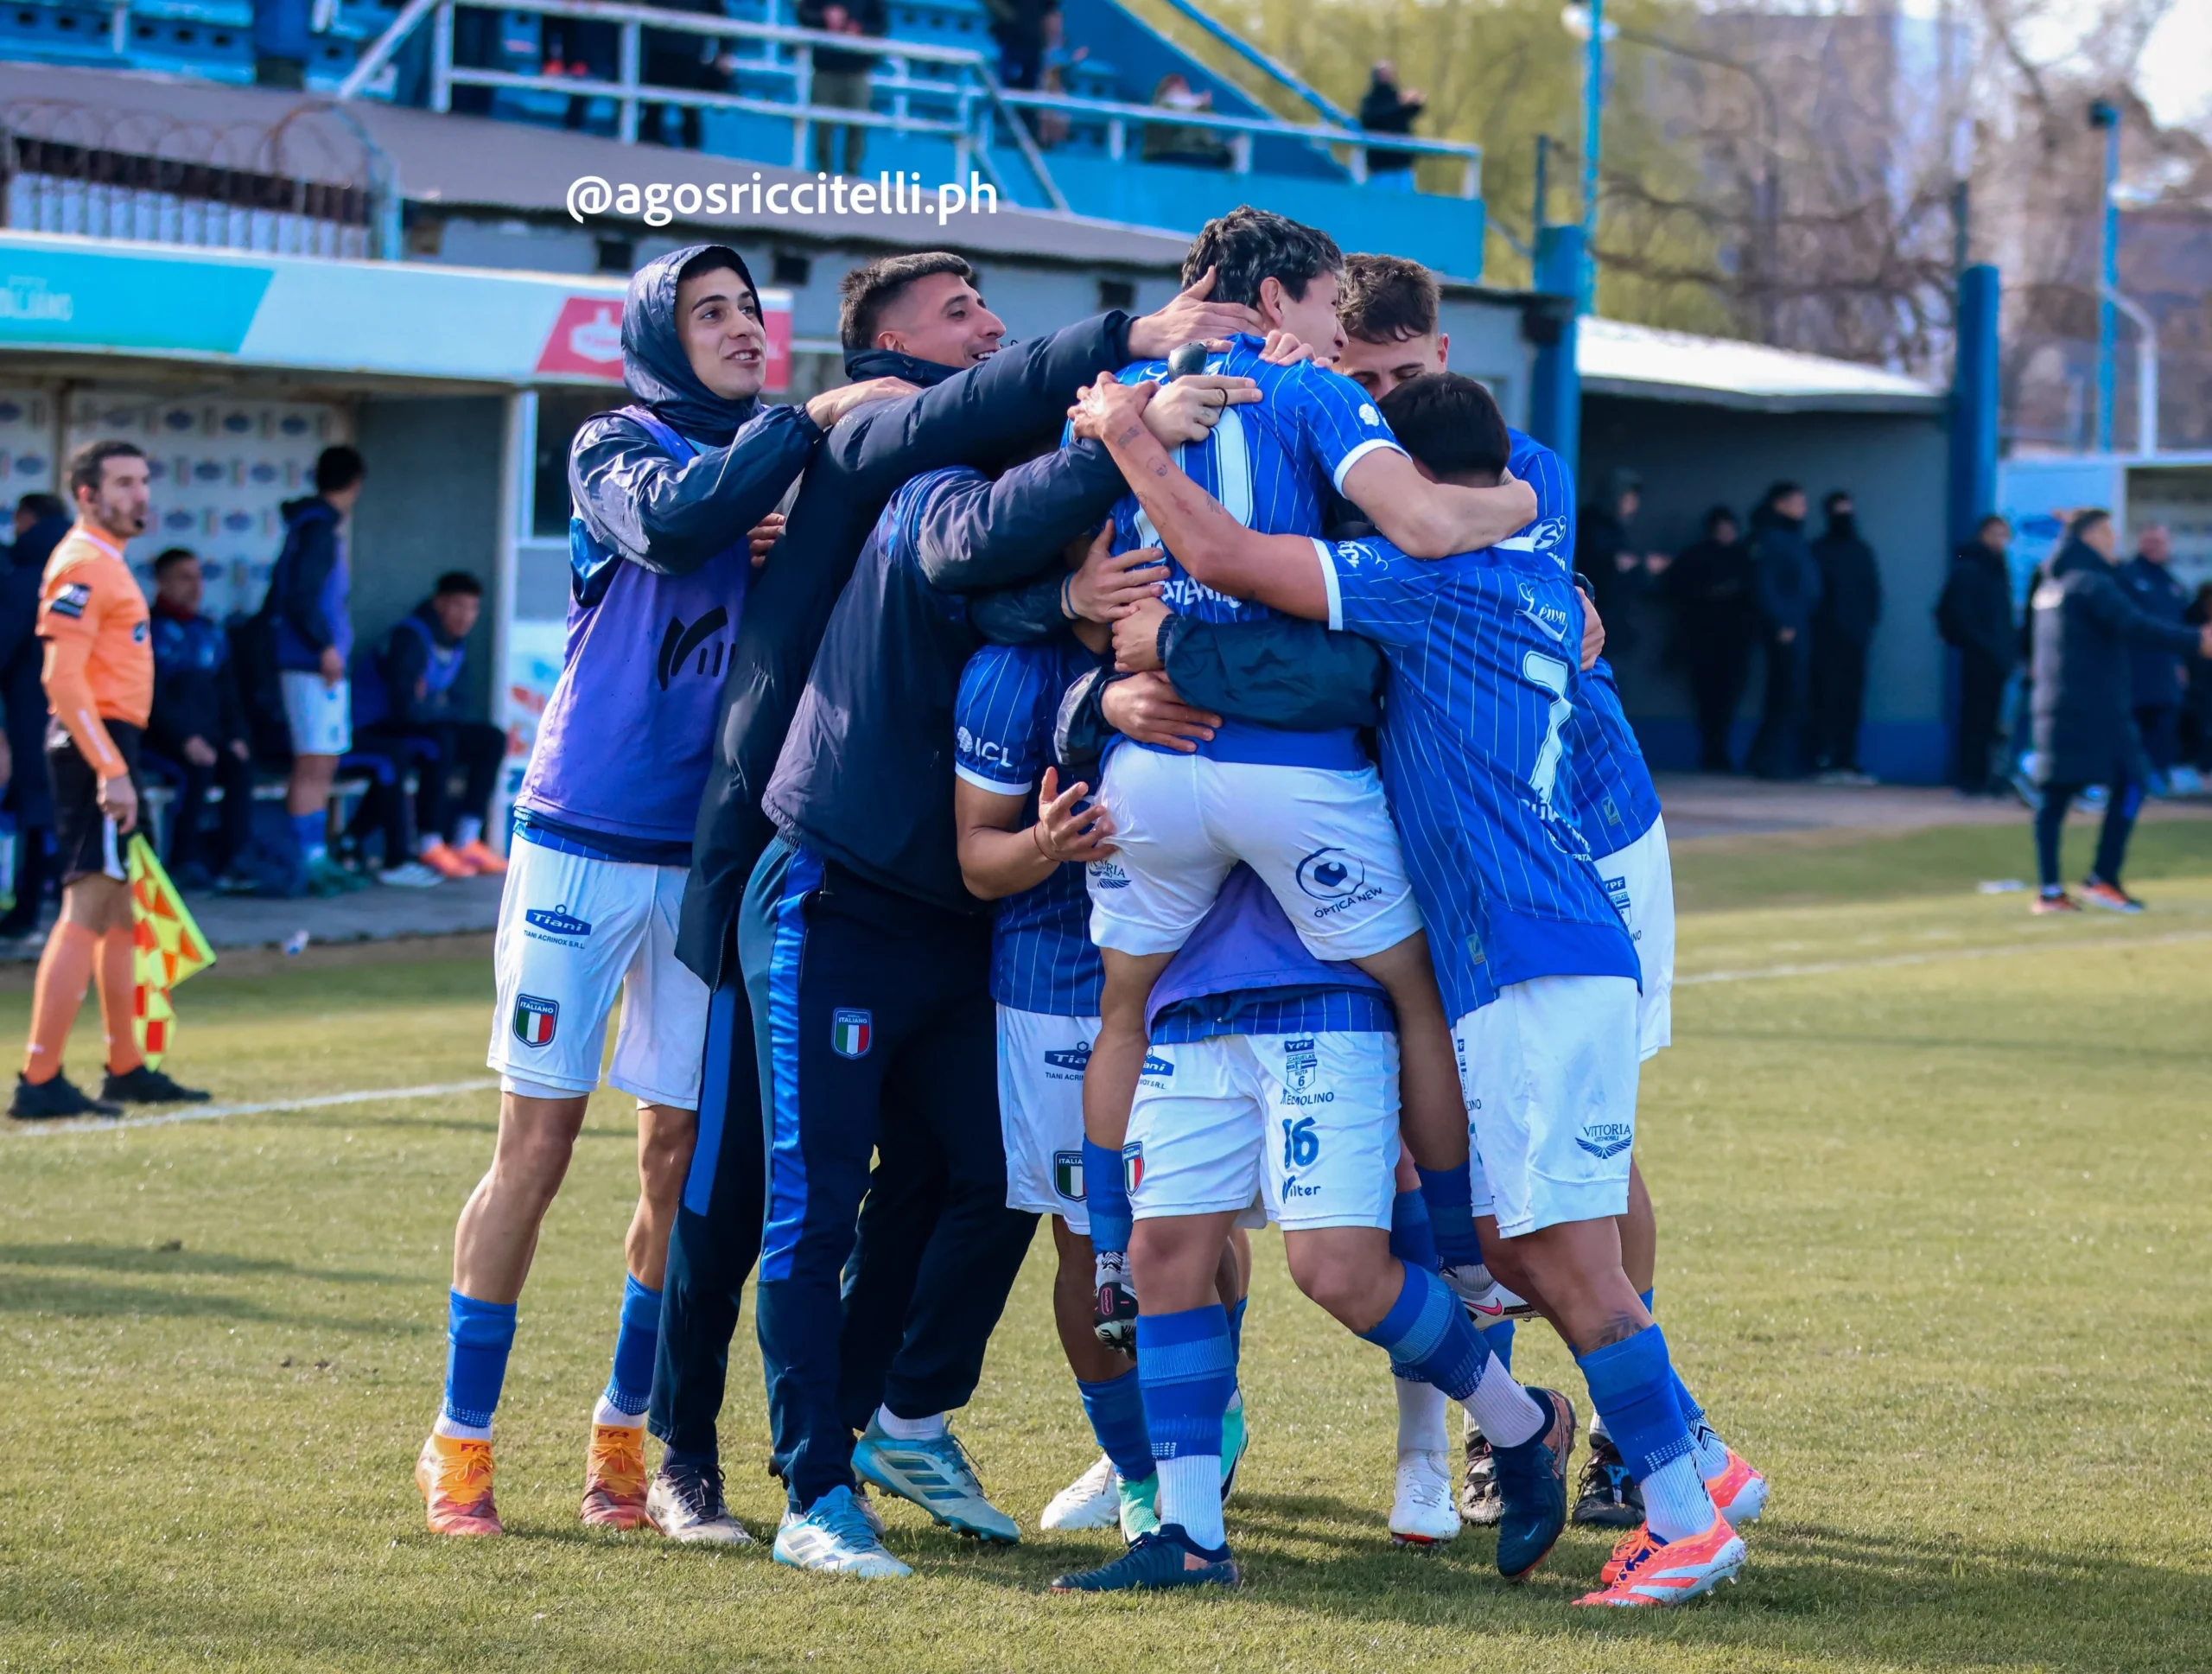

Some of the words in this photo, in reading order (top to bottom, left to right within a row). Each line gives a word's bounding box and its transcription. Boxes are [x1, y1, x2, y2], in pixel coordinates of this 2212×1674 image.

[975, 736, 1013, 767] ICL
[1313, 896, 1357, 918] ÓPTICA
[1357, 887, 1382, 902] NEW
[533, 913, 583, 932] Tiani
[524, 929, 537, 939] TIANI
[537, 933, 568, 945] ACRINOX
[520, 1002, 554, 1014] ITALIANO
[1287, 1041, 1312, 1050] YPF
[1298, 1076, 1306, 1087] 6
[1583, 1123, 1630, 1137] VITTORIA
[1282, 1117, 1319, 1169] 16
